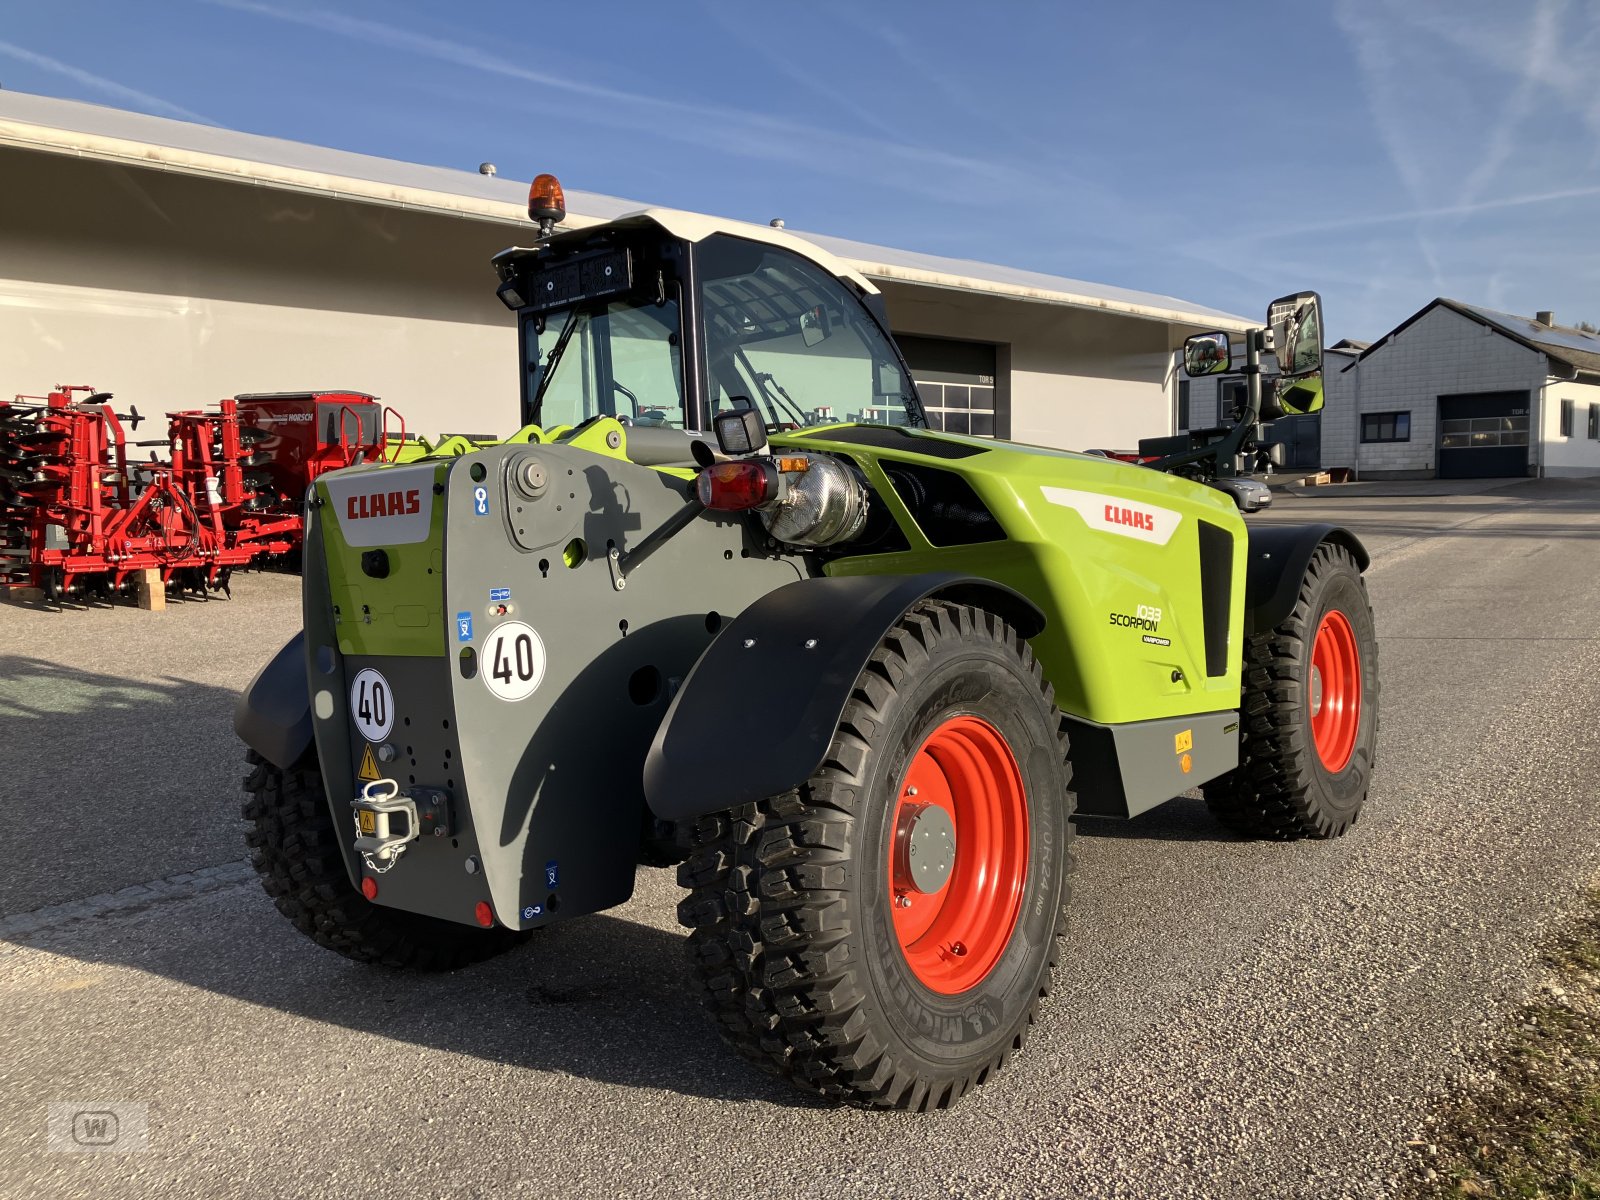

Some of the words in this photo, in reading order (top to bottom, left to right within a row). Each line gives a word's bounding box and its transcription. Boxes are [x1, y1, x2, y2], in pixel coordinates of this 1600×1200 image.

[289, 413, 313, 422] HORSCH
[347, 489, 420, 520] CLAAS
[1105, 505, 1153, 531] CLAAS
[1110, 613, 1158, 632] SCORPION
[1137, 604, 1162, 622] 1033
[493, 633, 534, 685] 40
[358, 680, 386, 727] 40
[1035, 893, 1044, 917] IND
